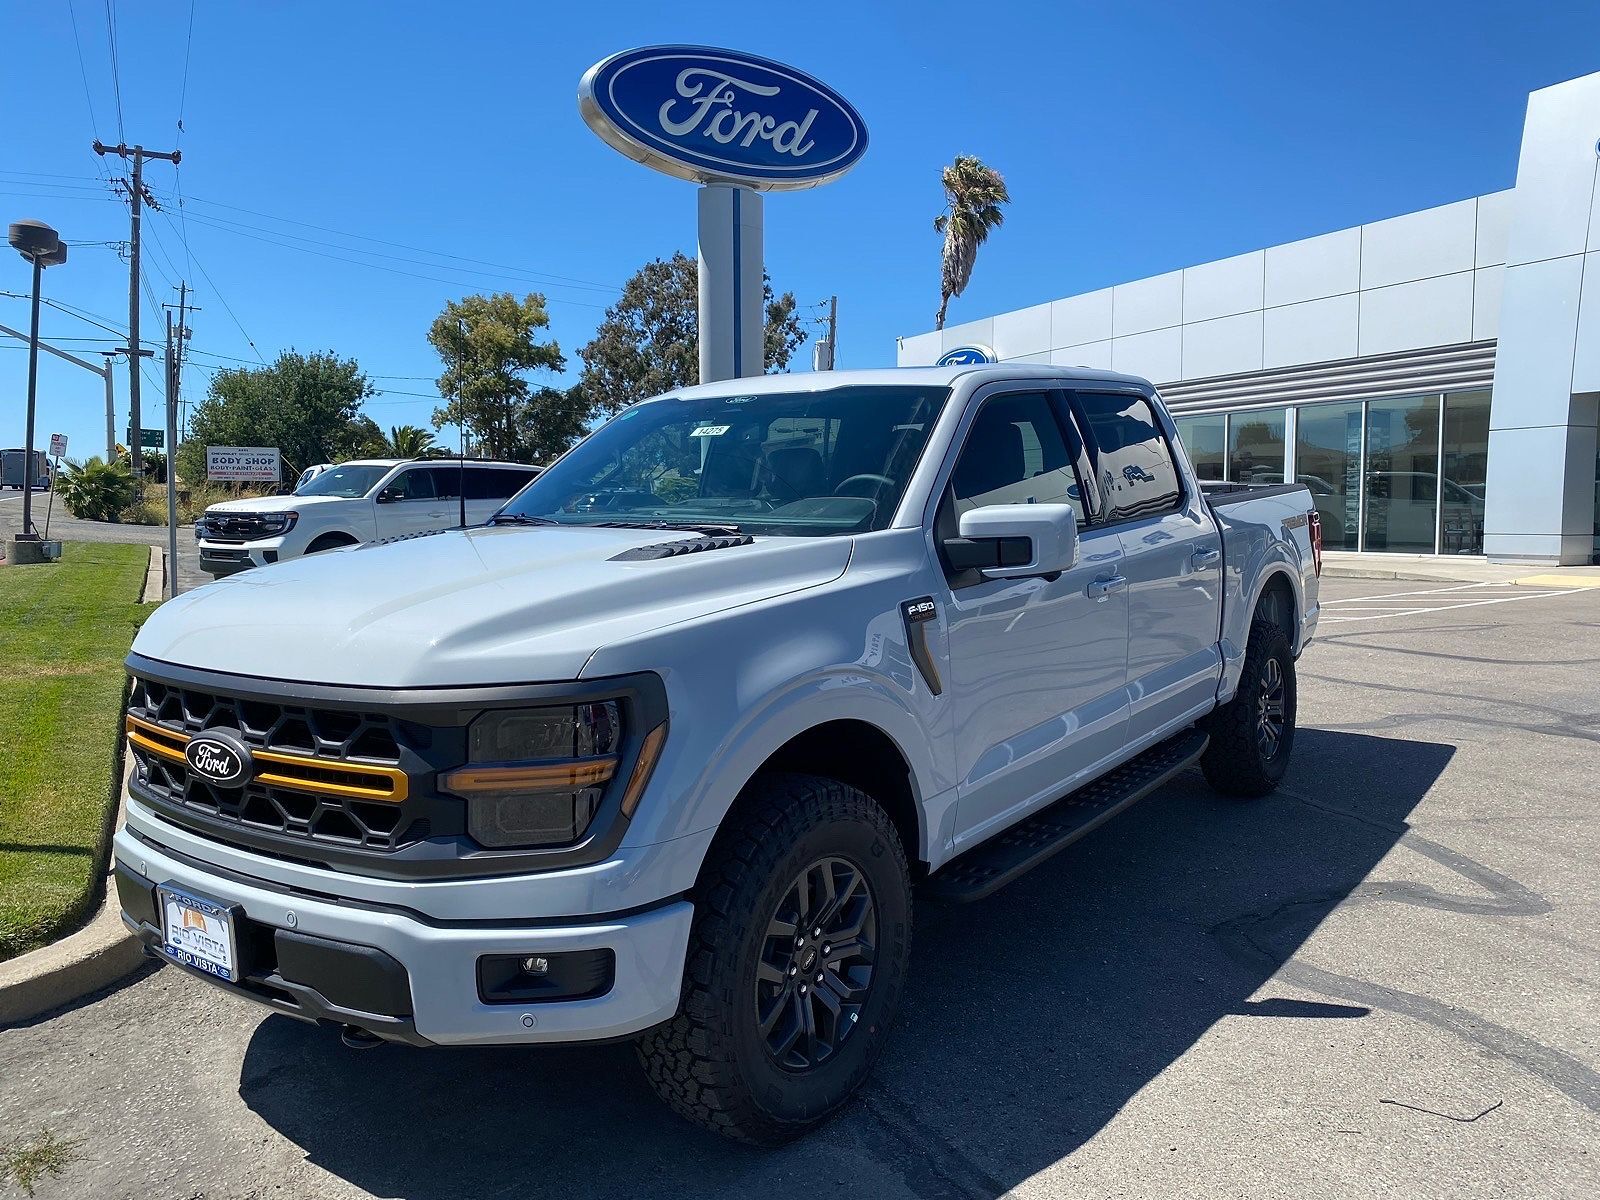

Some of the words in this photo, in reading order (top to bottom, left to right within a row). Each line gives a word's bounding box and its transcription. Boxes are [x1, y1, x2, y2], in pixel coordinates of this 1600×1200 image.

[659, 67, 819, 157] Ford
[212, 457, 242, 465] BODY
[245, 457, 275, 465] SHOP
[908, 601, 935, 615] F-150
[195, 743, 230, 775] Ford
[175, 895, 212, 914] FORD
[171, 924, 190, 942] RIO
[193, 932, 226, 954] VISTA
[177, 949, 192, 963] RIO
[193, 955, 218, 974] VISTA
